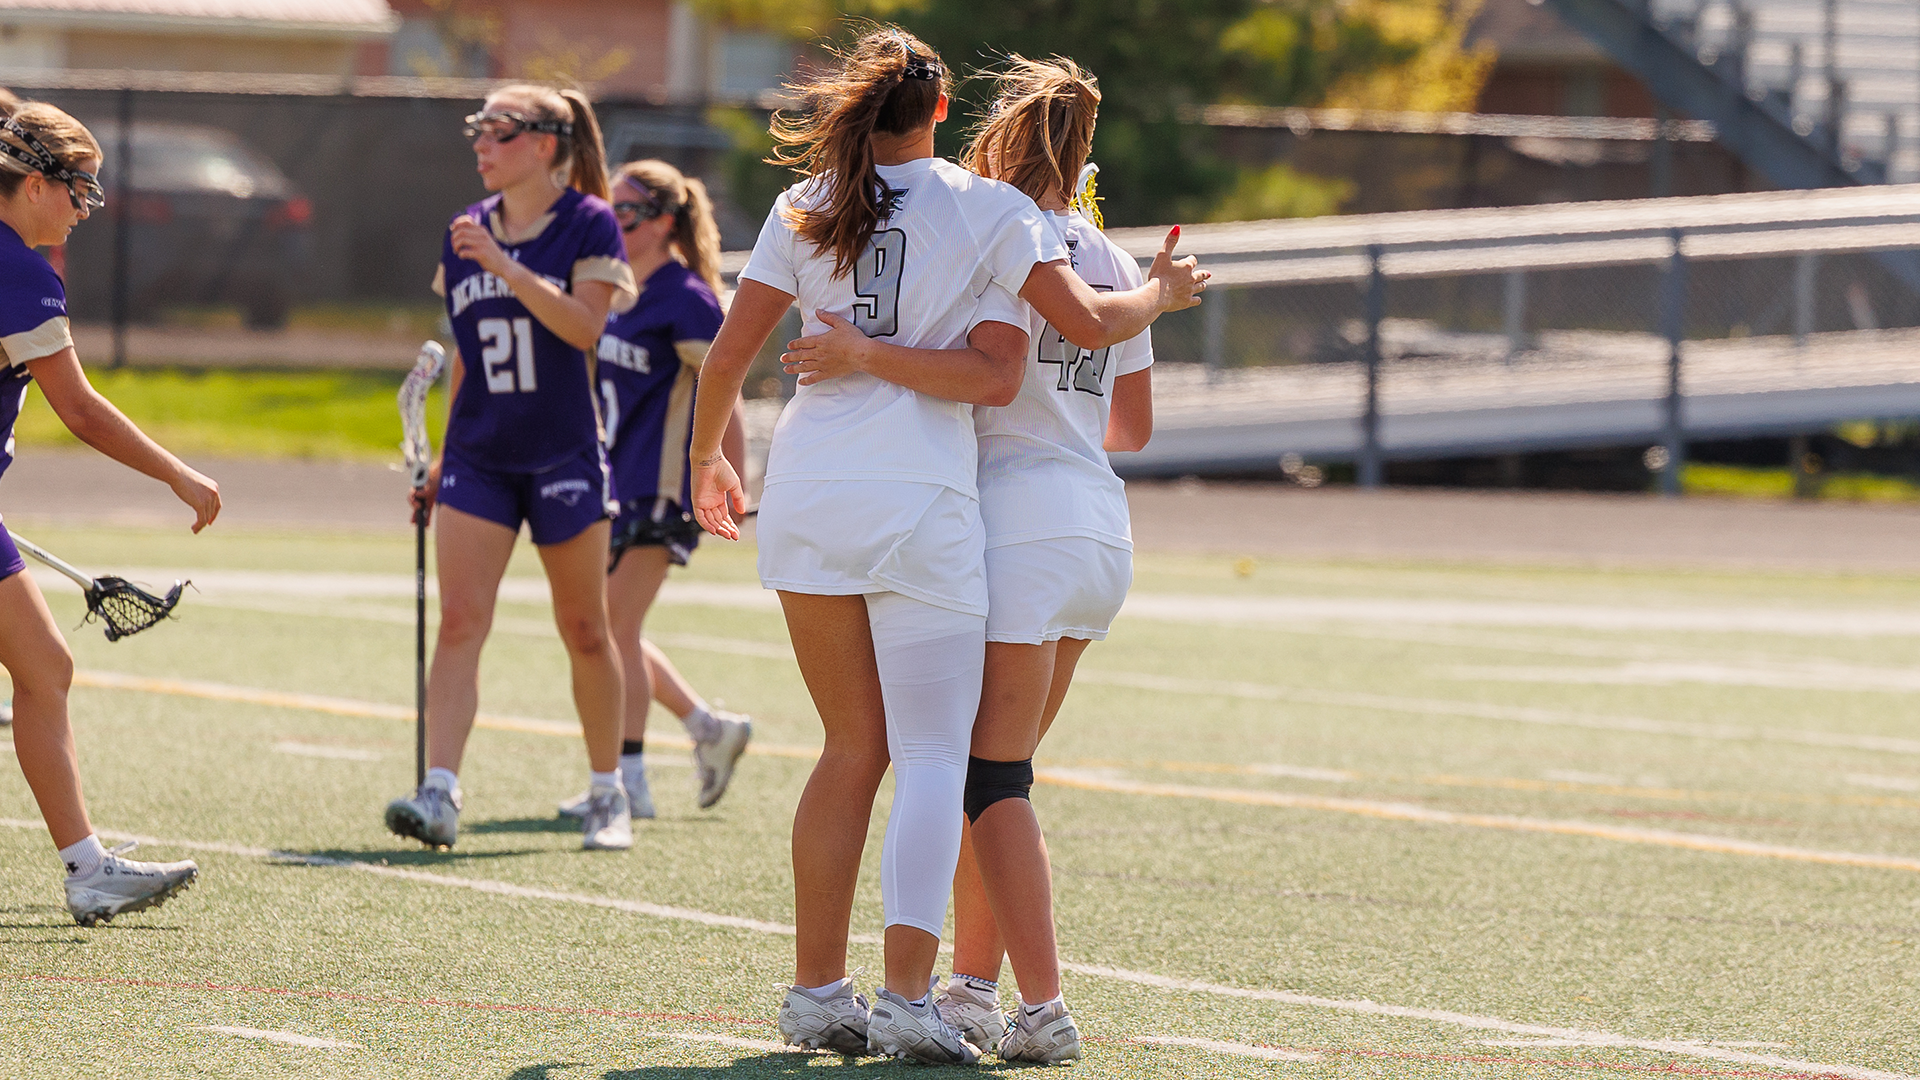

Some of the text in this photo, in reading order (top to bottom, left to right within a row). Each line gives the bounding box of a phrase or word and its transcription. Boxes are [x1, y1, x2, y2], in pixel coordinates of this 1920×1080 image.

[17, 151, 46, 171] STX
[30, 140, 56, 166] STX
[852, 228, 907, 338] 9
[477, 317, 538, 393] 21
